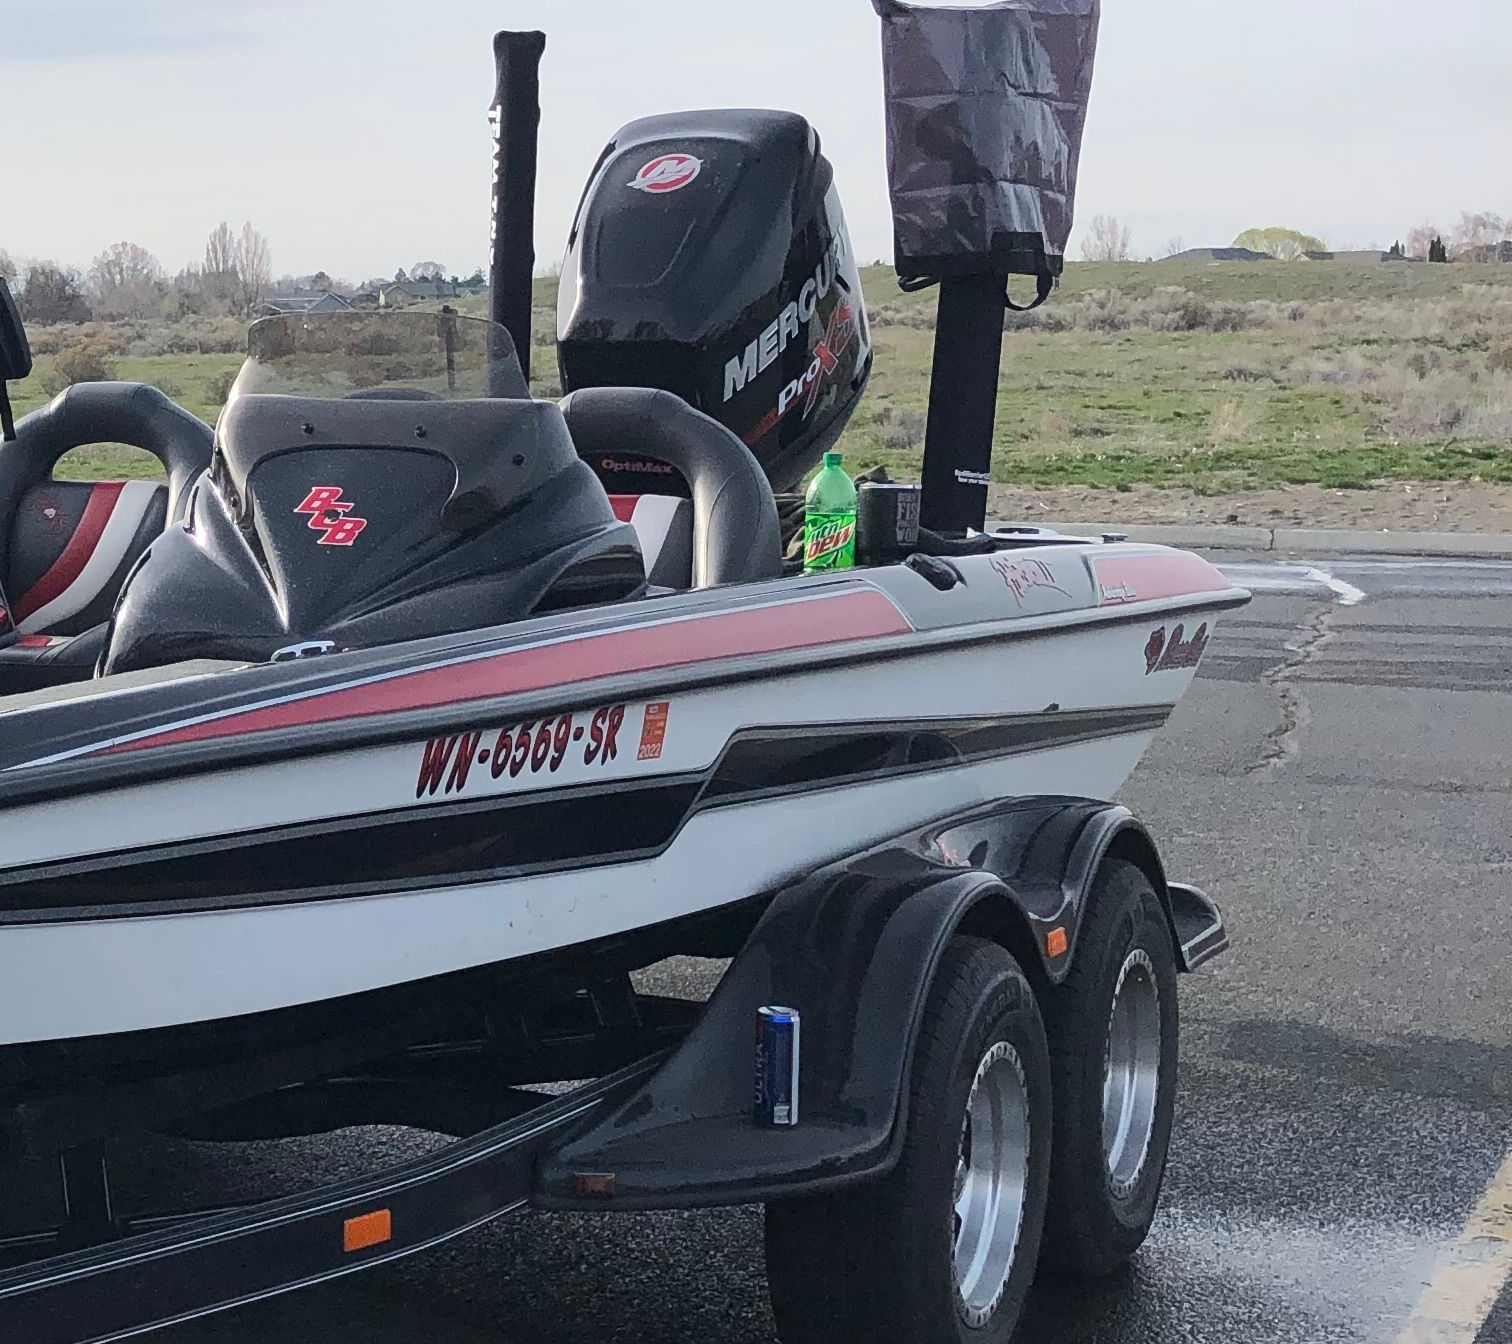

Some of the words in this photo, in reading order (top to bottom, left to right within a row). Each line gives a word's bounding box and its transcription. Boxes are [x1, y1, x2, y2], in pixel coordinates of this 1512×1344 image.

[601, 458, 672, 474] OptiMax
[416, 705, 625, 799] WN-6569-SR
[638, 742, 661, 759] 2022
